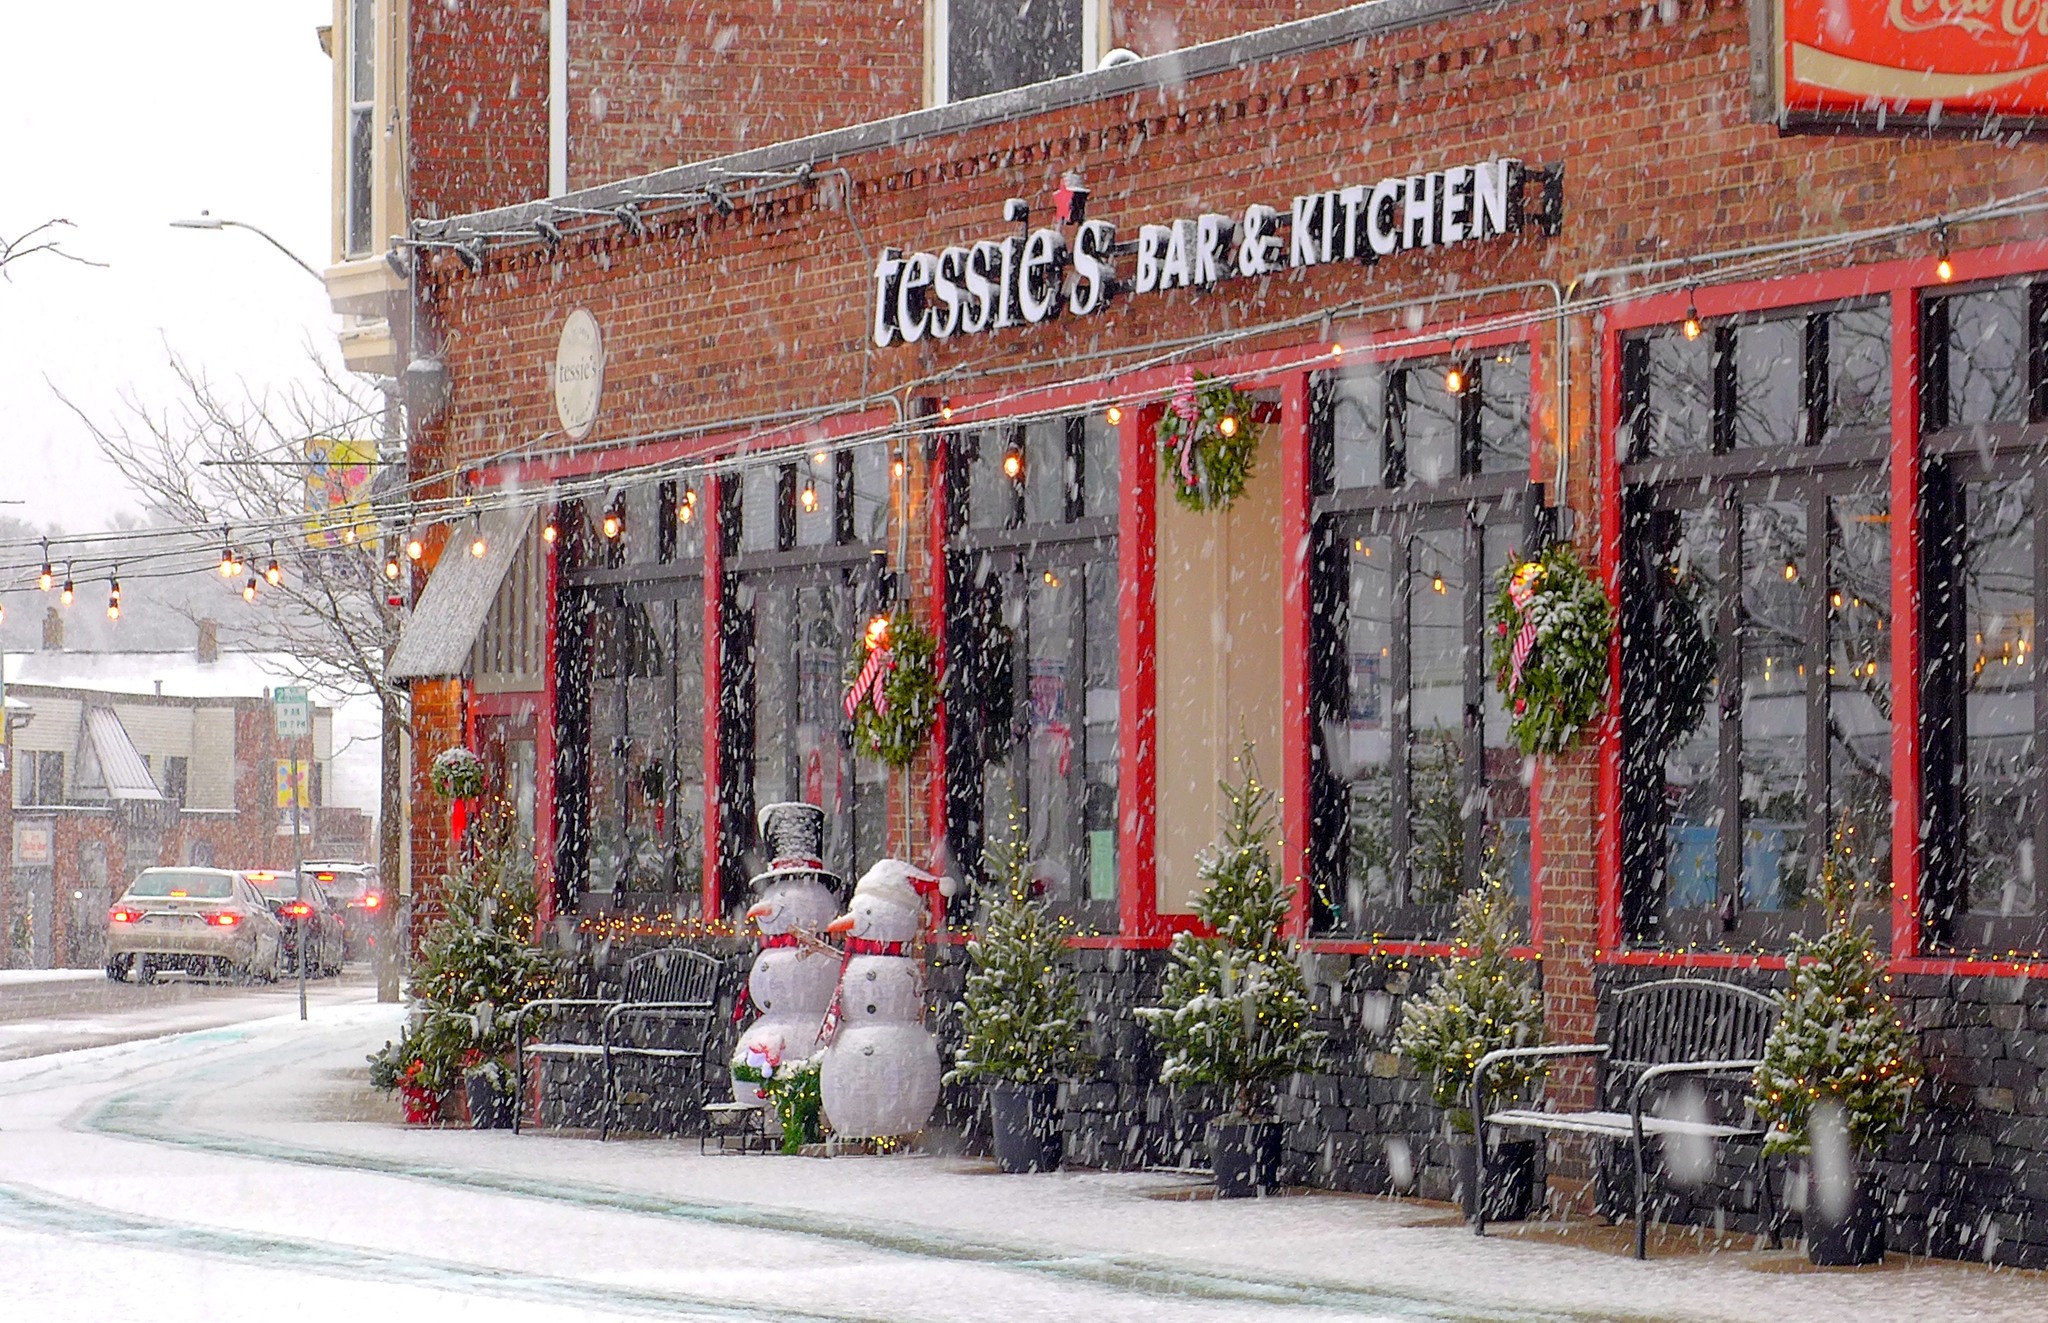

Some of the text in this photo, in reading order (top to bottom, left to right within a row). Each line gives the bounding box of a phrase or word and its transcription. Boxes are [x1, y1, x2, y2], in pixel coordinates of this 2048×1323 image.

[874, 159, 1521, 347] tessie's BAR & KITCHEN
[559, 354, 598, 384] tessie's
